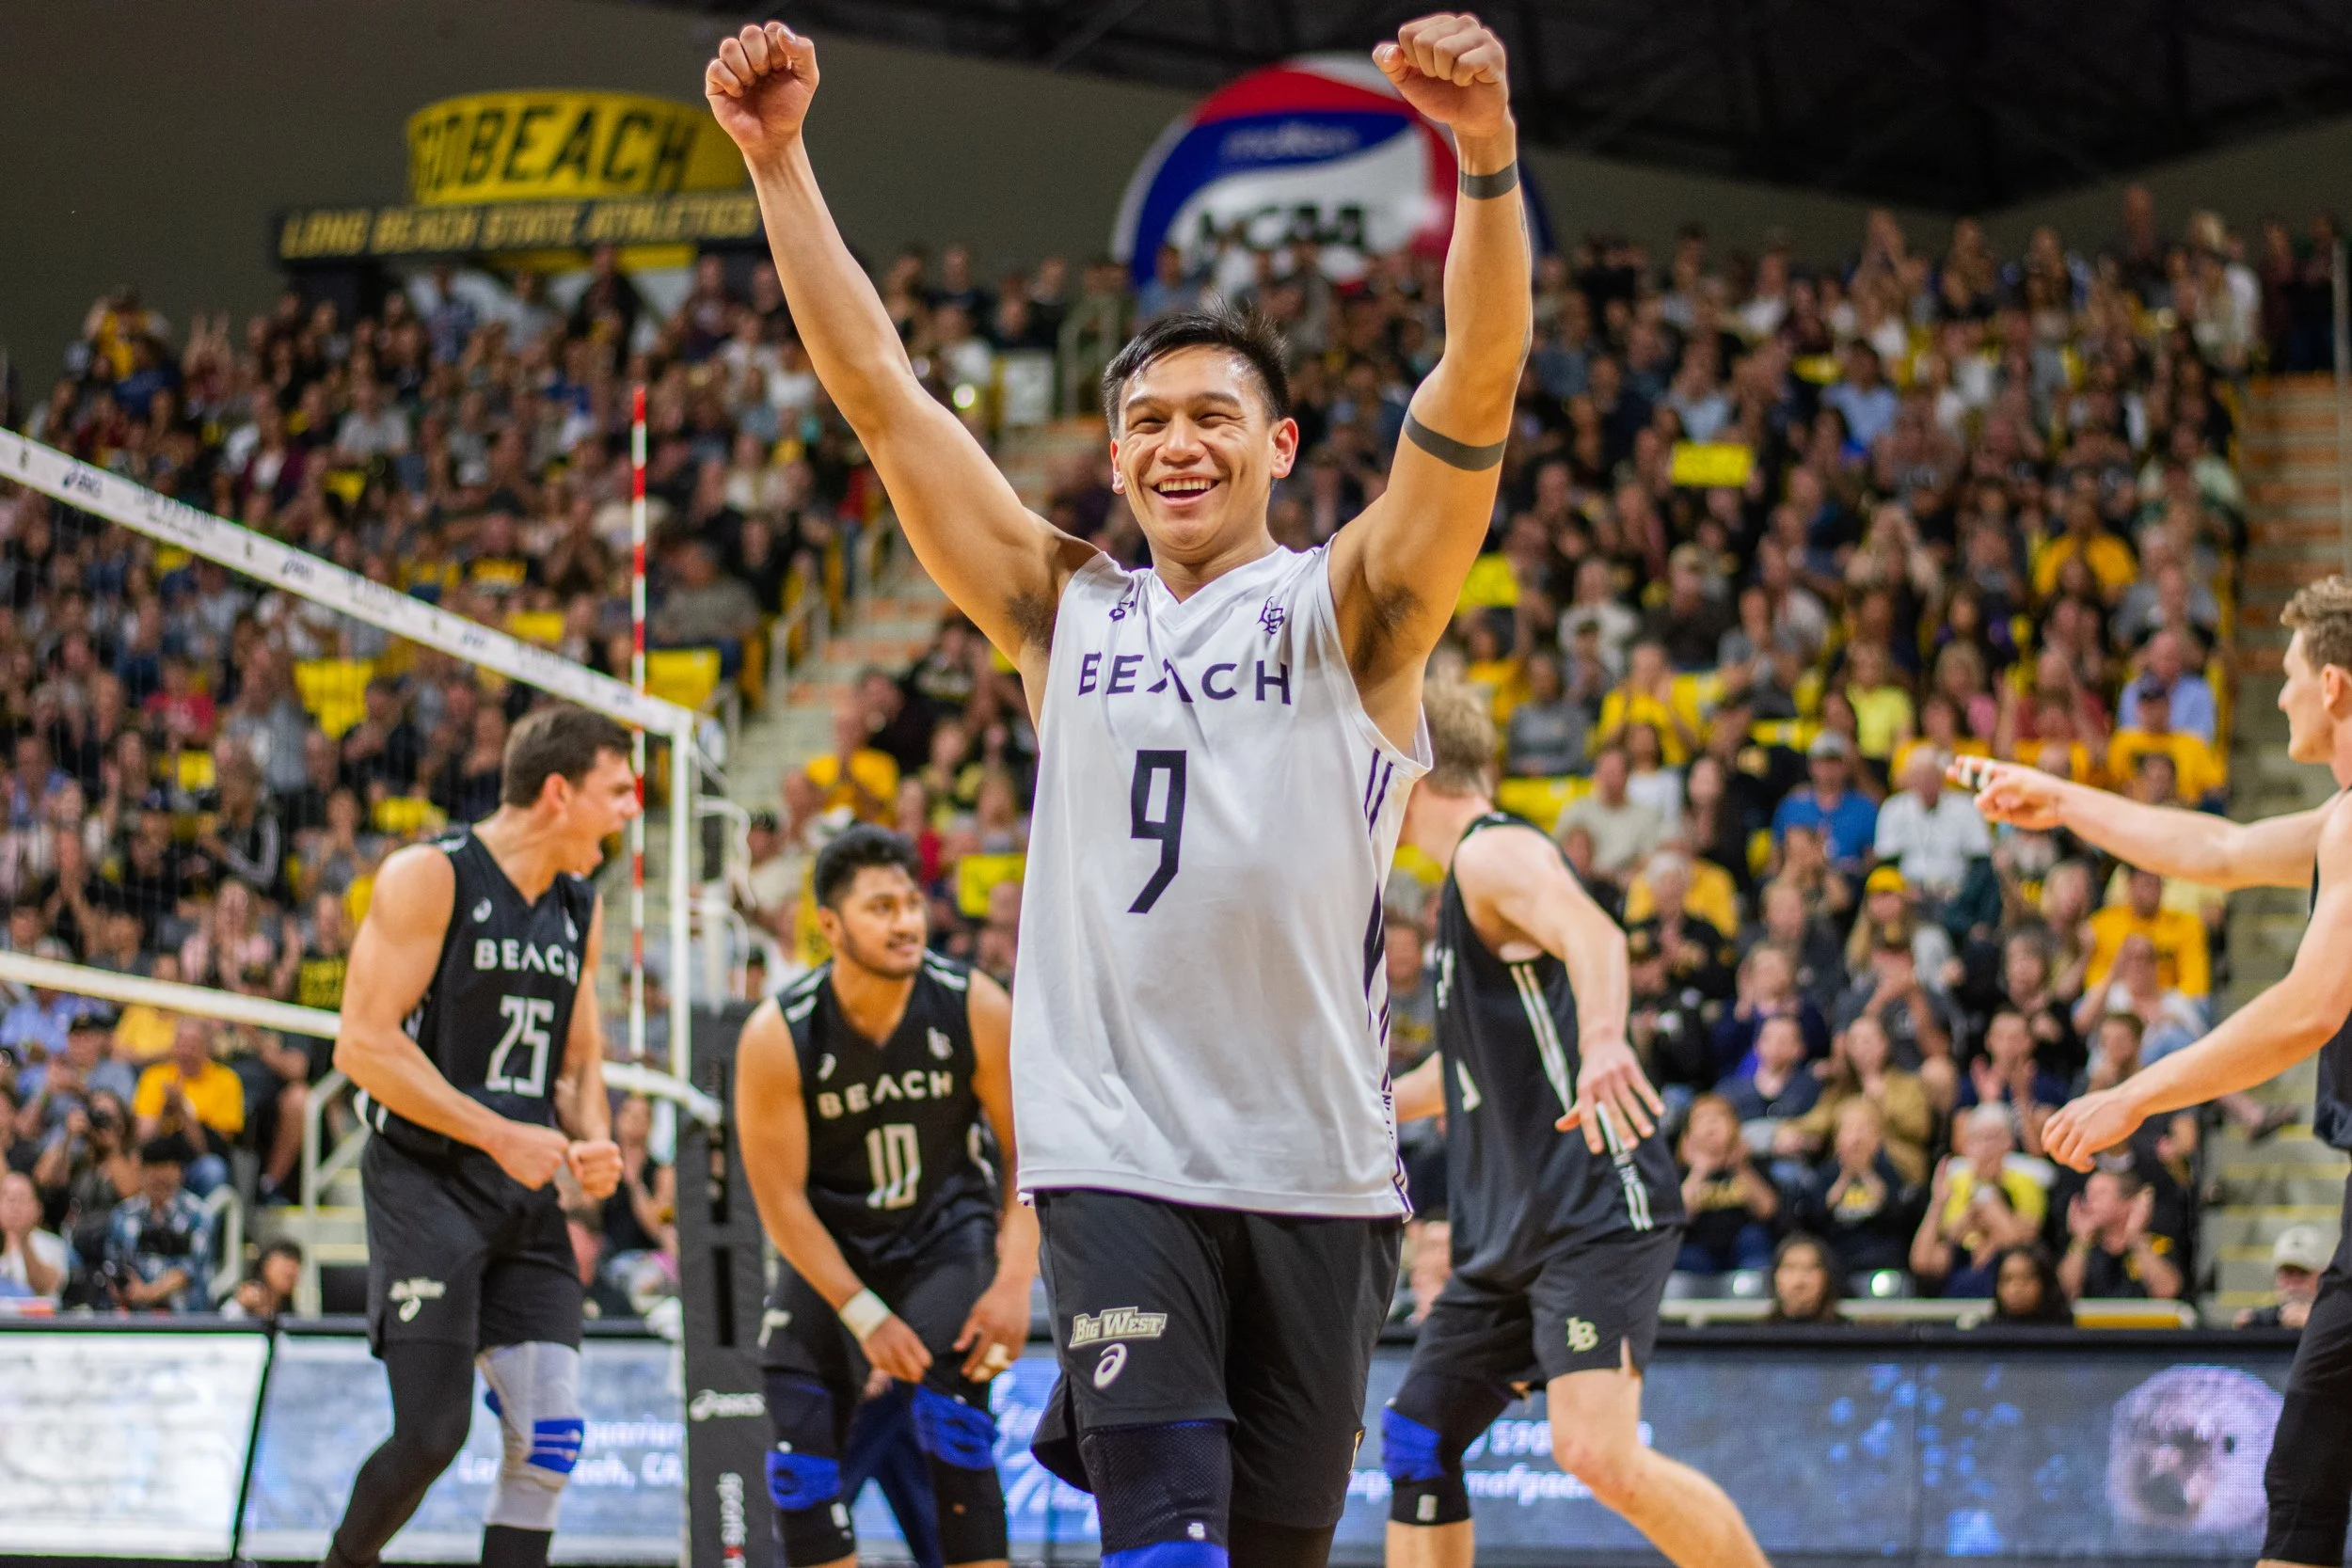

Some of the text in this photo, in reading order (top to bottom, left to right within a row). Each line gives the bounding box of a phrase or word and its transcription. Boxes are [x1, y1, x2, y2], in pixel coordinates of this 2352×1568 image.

[1078, 651, 1292, 705] BEACH
[1127, 750, 1187, 914] 9
[473, 938, 580, 987] BEACH
[485, 993, 555, 1099] 25
[817, 1069, 954, 1120] BEACH
[865, 1123, 922, 1211] 10
